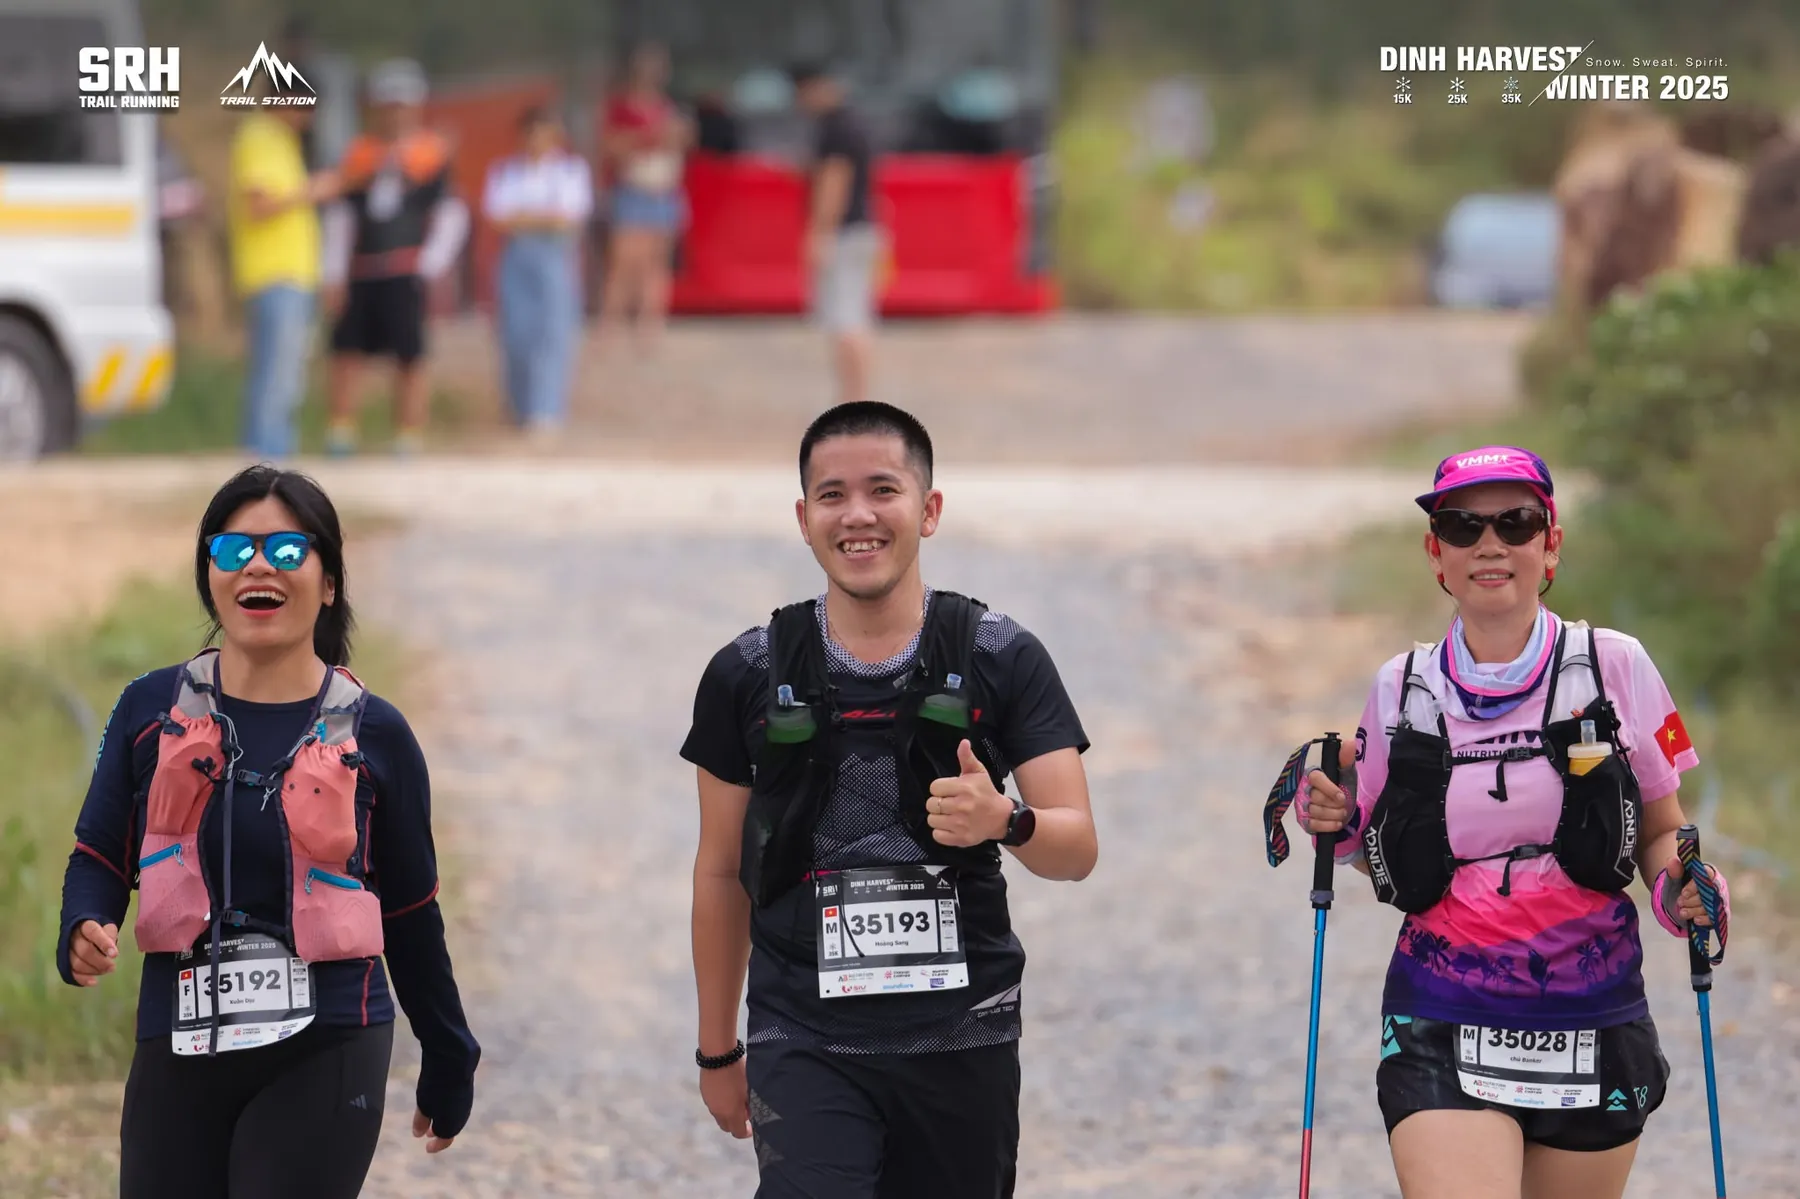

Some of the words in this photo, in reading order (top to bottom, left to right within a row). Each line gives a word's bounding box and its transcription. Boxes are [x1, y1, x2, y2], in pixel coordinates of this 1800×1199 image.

[825, 922, 838, 934] M
[850, 911, 930, 936] 35193
[184, 984, 190, 996] F
[204, 969, 281, 996] 35192
[1463, 1028, 1475, 1040] M
[1487, 1027, 1568, 1052] 35028
